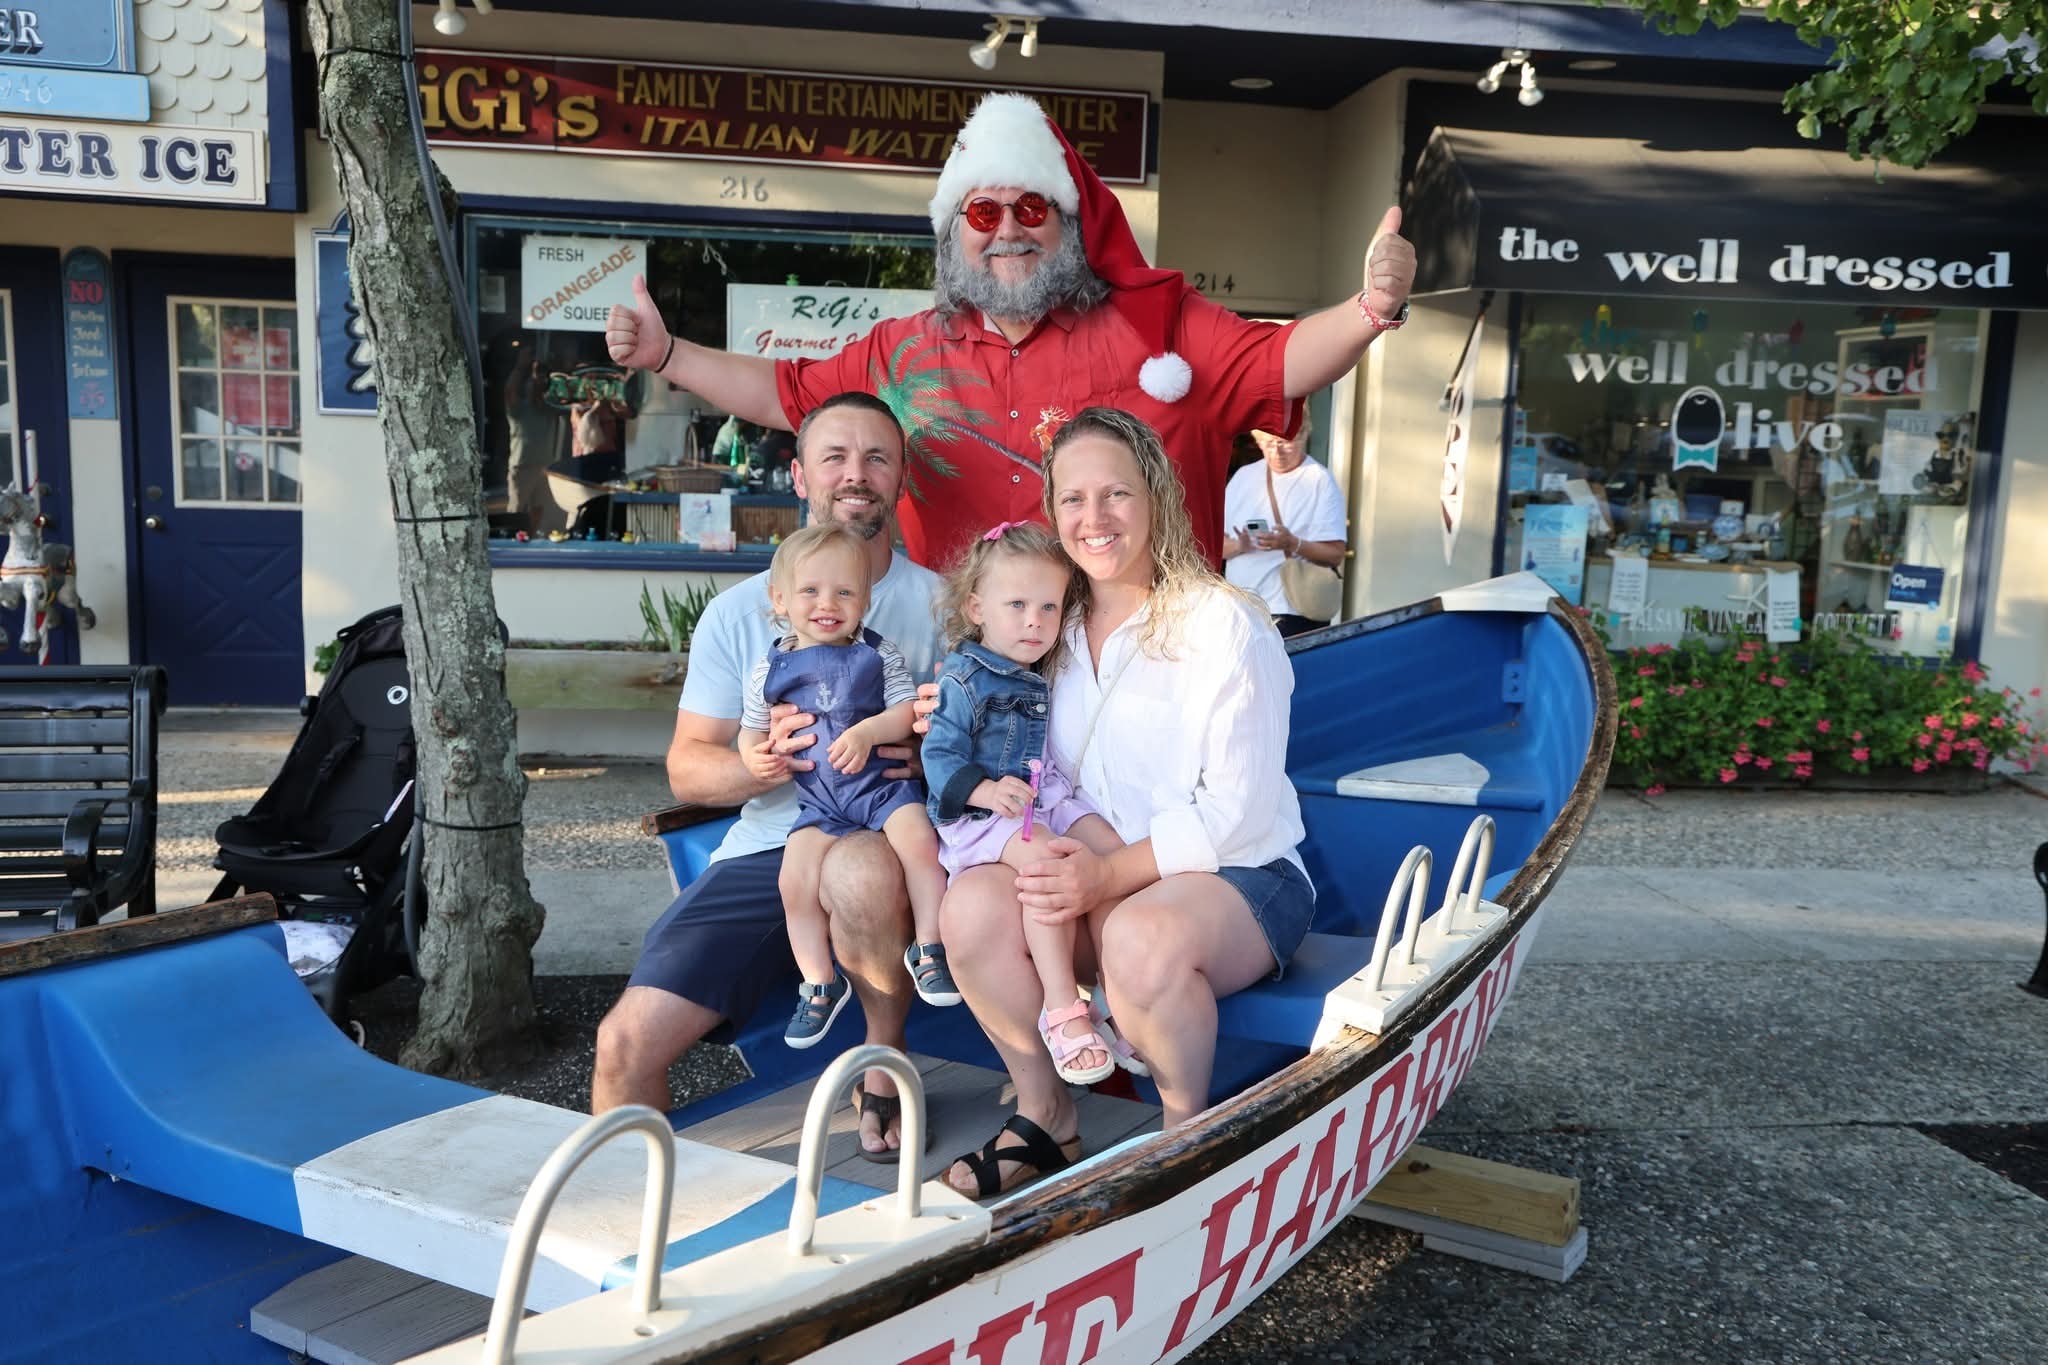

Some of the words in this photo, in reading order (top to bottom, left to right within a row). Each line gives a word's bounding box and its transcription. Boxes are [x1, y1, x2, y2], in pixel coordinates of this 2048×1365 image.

[616, 63, 722, 109] FAMILY
[639, 115, 819, 153] ITALIAN
[139, 136, 238, 186] ICE
[719, 175, 769, 203] 216
[538, 247, 584, 262] FRESH
[1498, 226, 1580, 262] the
[1603, 238, 1740, 283] well
[1768, 244, 2014, 292] dressed
[69, 279, 104, 305] NO
[531, 245, 636, 321] ORANGEADE
[1193, 272, 1236, 294] 214
[755, 328, 838, 354] Gourmet
[1564, 339, 1689, 385] well
[1715, 349, 1939, 396] dressed
[1891, 572, 1927, 590] Open
[1157, 935, 1518, 1357] HARBOR
